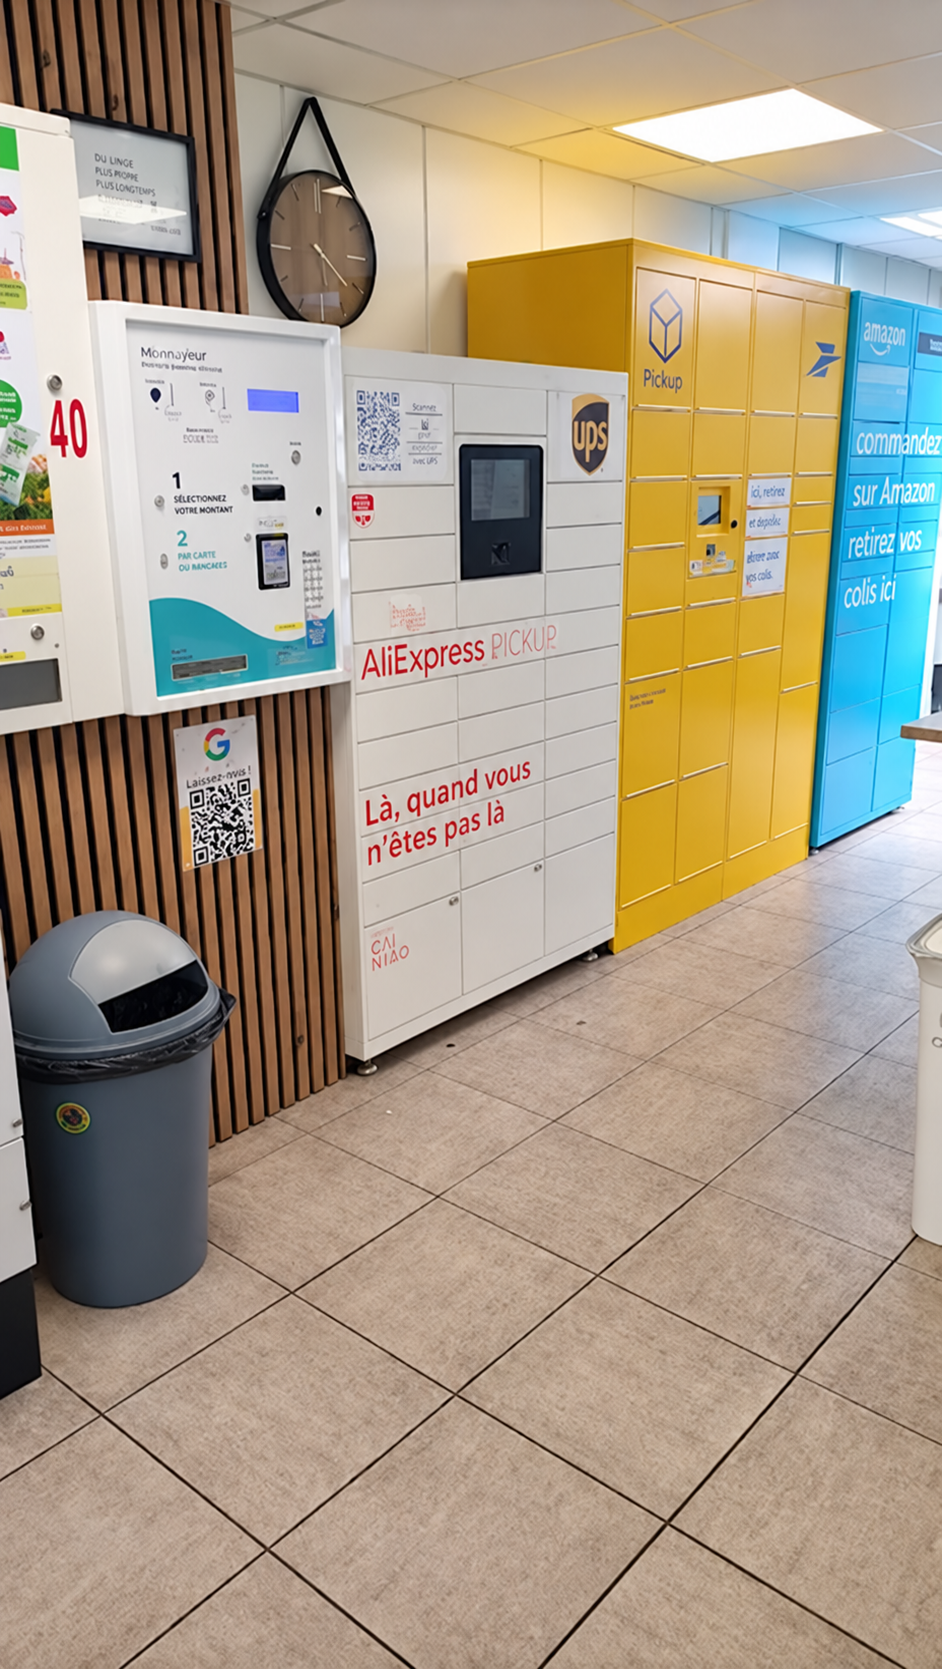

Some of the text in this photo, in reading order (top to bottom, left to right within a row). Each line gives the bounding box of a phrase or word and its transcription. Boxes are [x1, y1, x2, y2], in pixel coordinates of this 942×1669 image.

[94, 153, 134, 169] DU LINGE
[95, 166, 113, 177] PLUS
[96, 179, 156, 197] PLUS LONGTEMPS
[863, 320, 905, 347] amazon
[141, 347, 207, 363] Monnayeur
[643, 368, 683, 394] Pickup
[50, 398, 88, 458] 40
[856, 427, 941, 455] commandez
[573, 421, 608, 463] ups
[172, 471, 181, 489] 1
[763, 485, 786, 498] retirez
[853, 476, 935, 507] sur Amazon
[174, 494, 227, 504] SÉLECTIONNEZ
[174, 506, 233, 515] VOTRE MONTANT
[176, 530, 188, 547] 2
[848, 526, 922, 559] retirez vos
[178, 551, 216, 561] PAR CARTE
[844, 573, 897, 609] colis ici
[361, 625, 557, 681] AliExpress PICKUP
[365, 760, 531, 827] Là, quand vous
[366, 799, 505, 866] n’êtes pas là
[371, 933, 396, 955] CAI
[372, 945, 410, 972] NIAO
